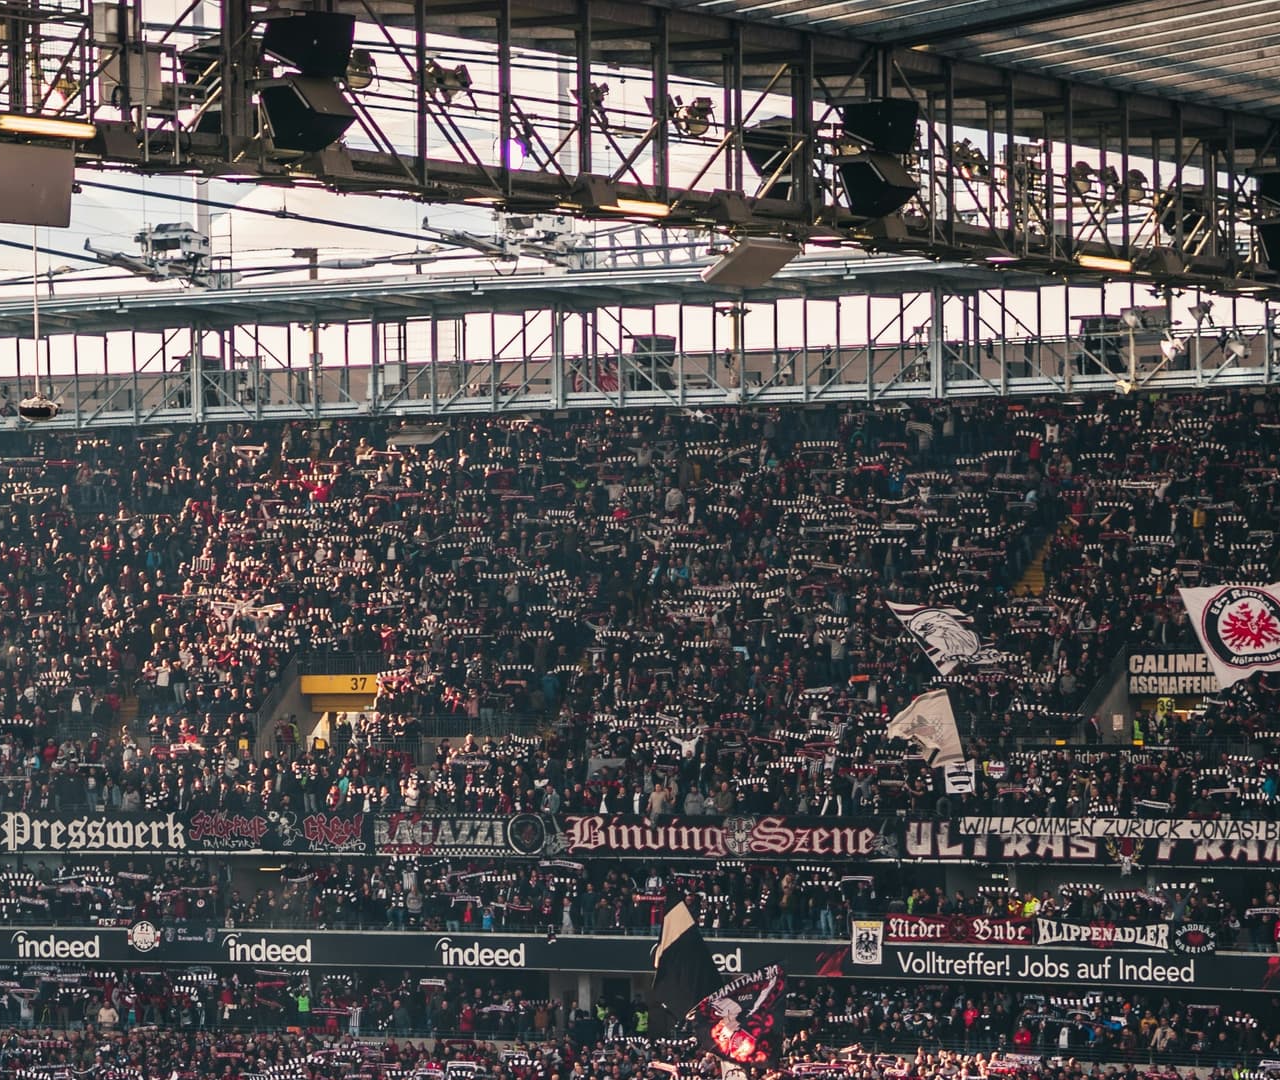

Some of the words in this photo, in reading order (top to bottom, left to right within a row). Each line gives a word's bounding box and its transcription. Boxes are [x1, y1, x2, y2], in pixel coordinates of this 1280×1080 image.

[1129, 654, 1211, 674] CALIME
[349, 676, 369, 691] 37
[1159, 700, 1173, 713] 39
[2, 811, 187, 850] Presswerk
[374, 818, 504, 847] RAGAZZI
[750, 815, 878, 854] Szene
[963, 816, 1094, 836] WILLKOMMEN
[1190, 820, 1260, 842] JONAS!
[888, 915, 946, 940] Nieder
[1037, 917, 1170, 951] KLIPPENADLER
[18, 933, 100, 959] indeed
[228, 937, 312, 963] indeed
[442, 942, 526, 968] indeed
[897, 951, 1011, 977] Volltreffer!
[1018, 955, 1069, 979] Jobs
[1077, 957, 1112, 981] auf
[1118, 958, 1195, 983] Indeed
